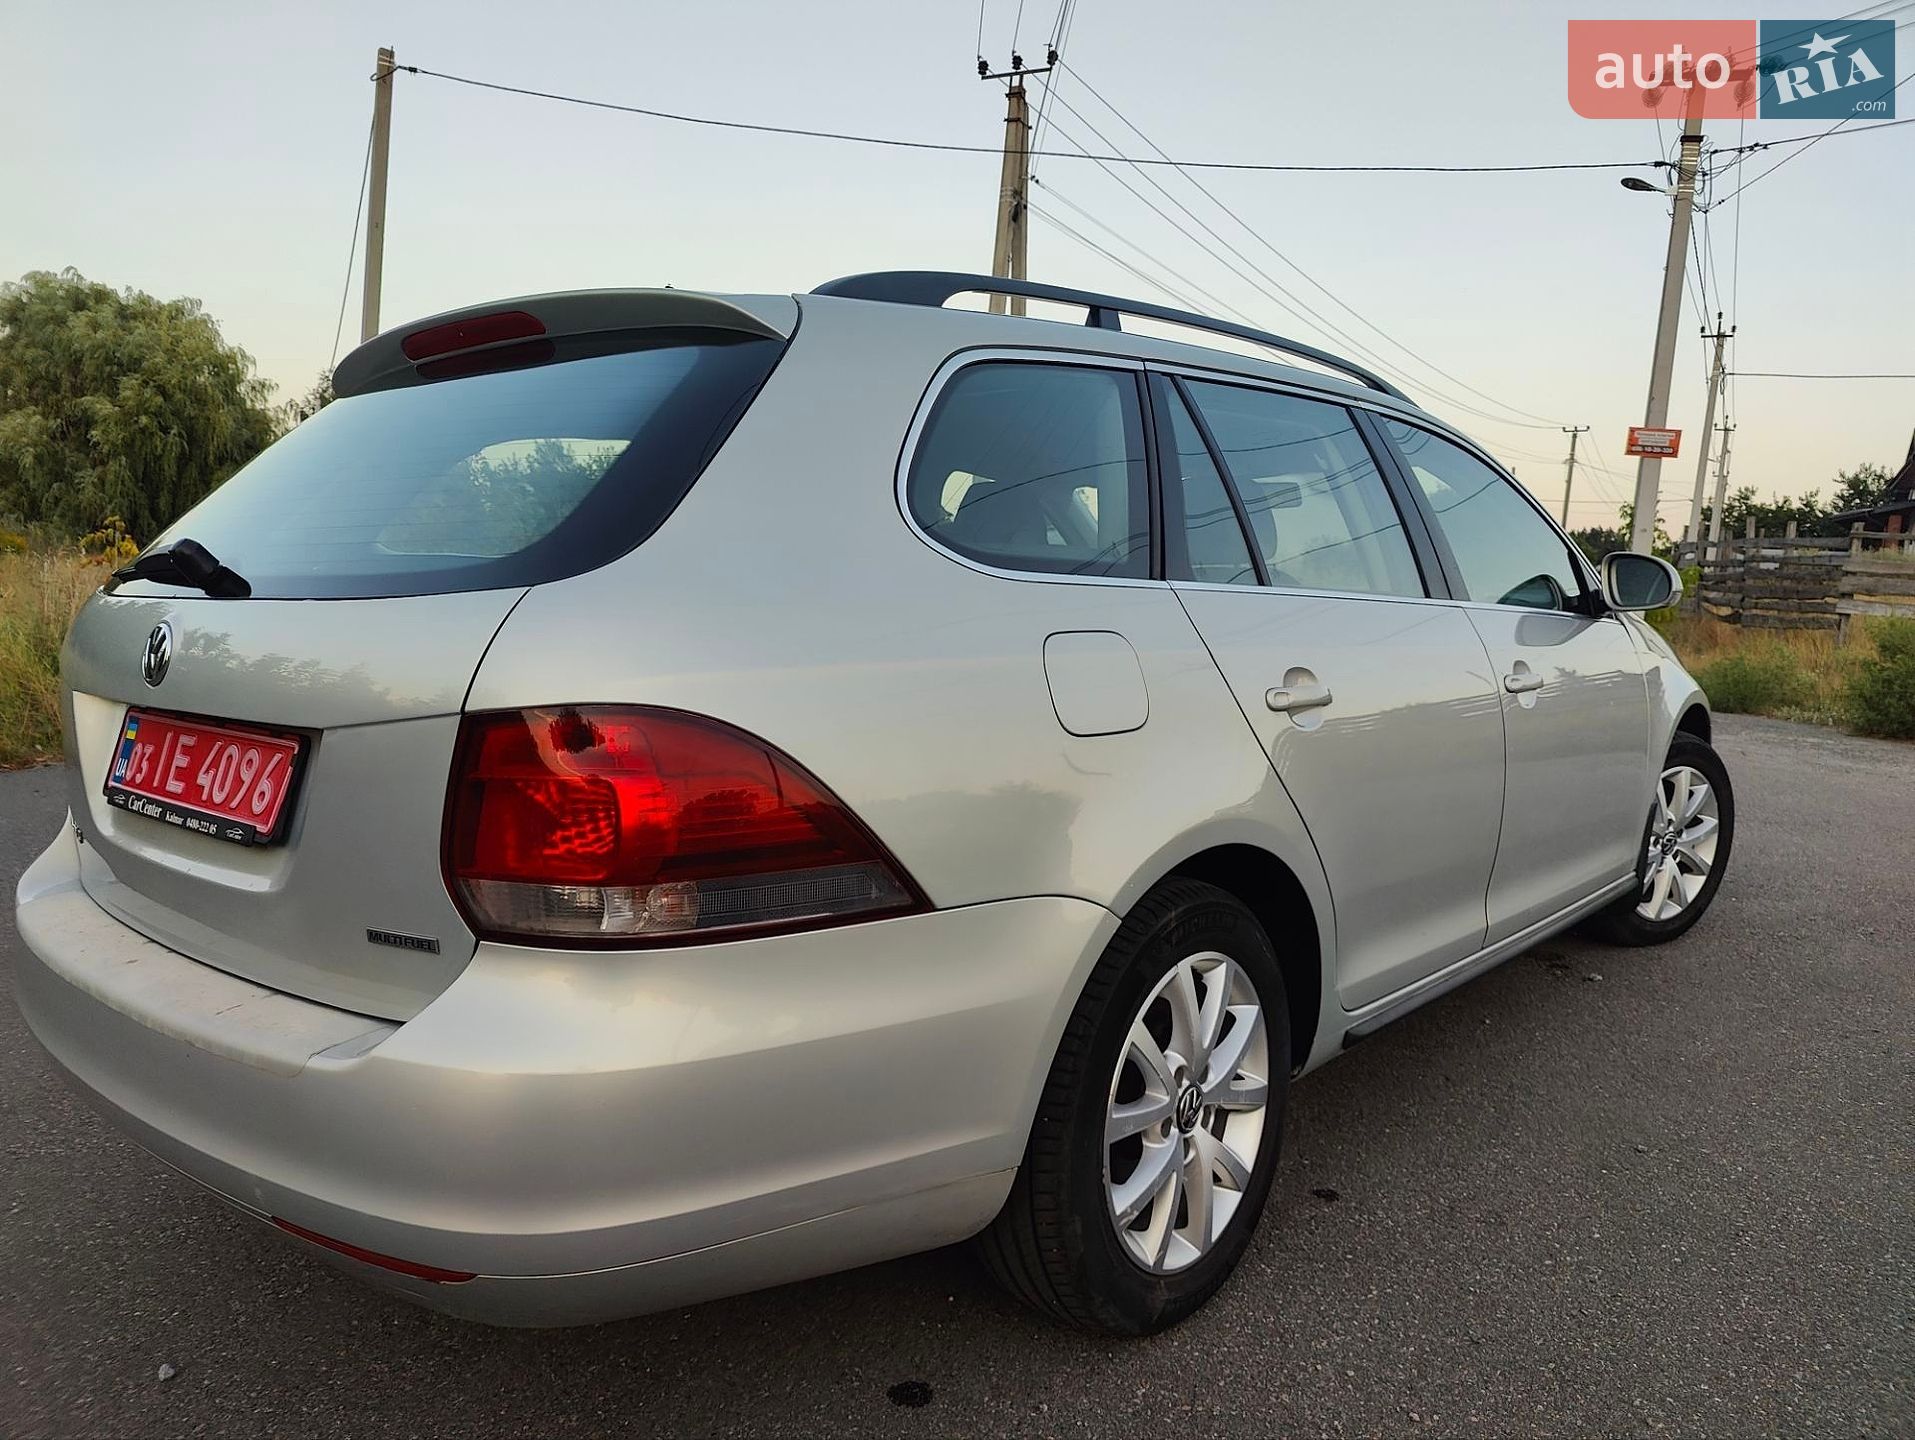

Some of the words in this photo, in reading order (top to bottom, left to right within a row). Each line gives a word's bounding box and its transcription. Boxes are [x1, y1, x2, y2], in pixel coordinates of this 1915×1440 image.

[115, 758, 127, 777] UA
[126, 743, 154, 784] 03
[197, 741, 283, 814] 4096
[127, 795, 162, 818] CarCenter
